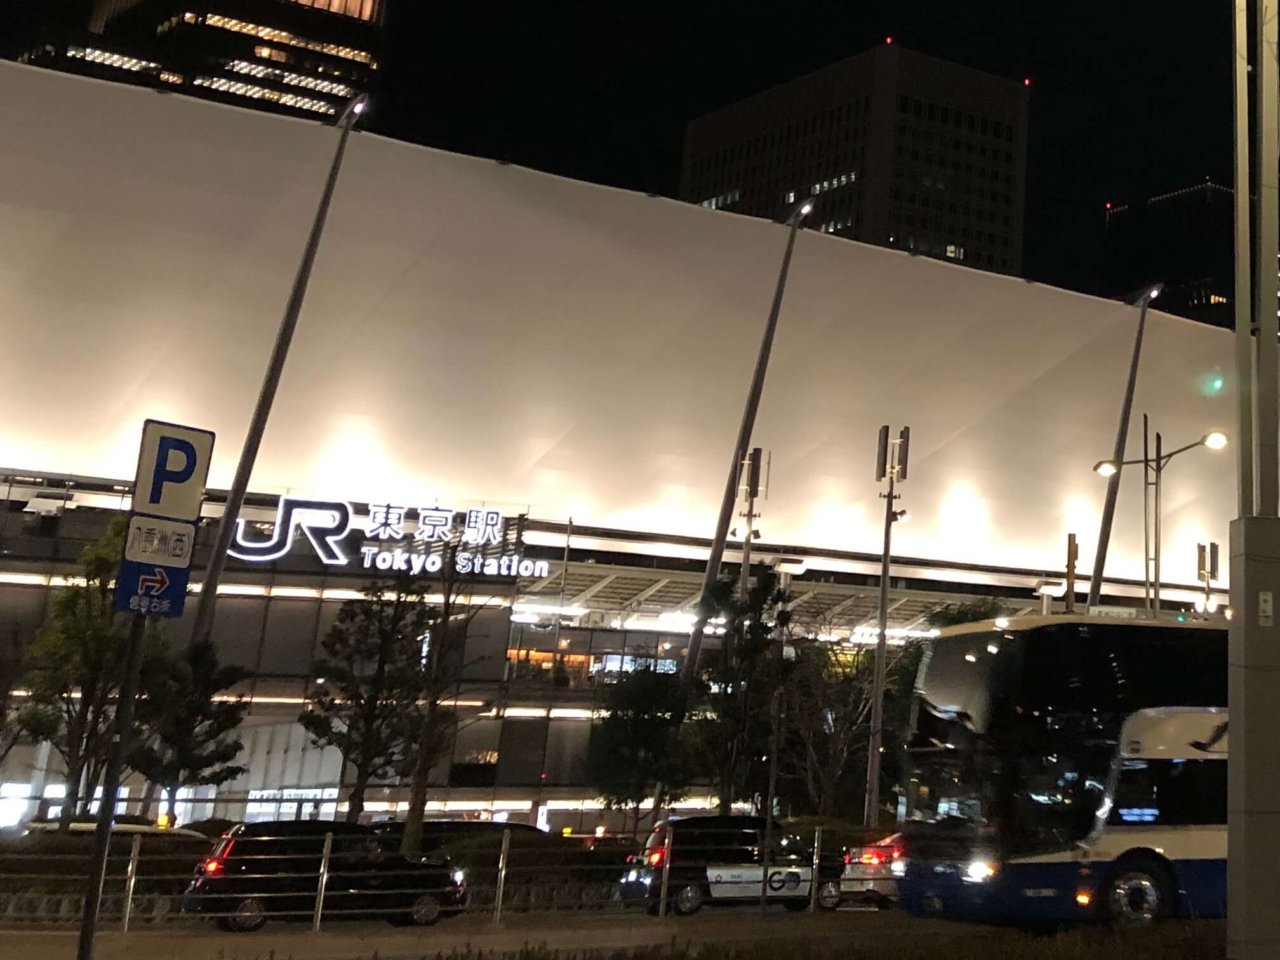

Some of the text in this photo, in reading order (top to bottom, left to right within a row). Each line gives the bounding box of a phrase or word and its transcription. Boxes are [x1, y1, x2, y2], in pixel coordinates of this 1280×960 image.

[148, 435, 197, 505] P
[226, 495, 349, 565] JR
[367, 502, 504, 545] 東京駅
[360, 546, 550, 578] Tokyo Station
